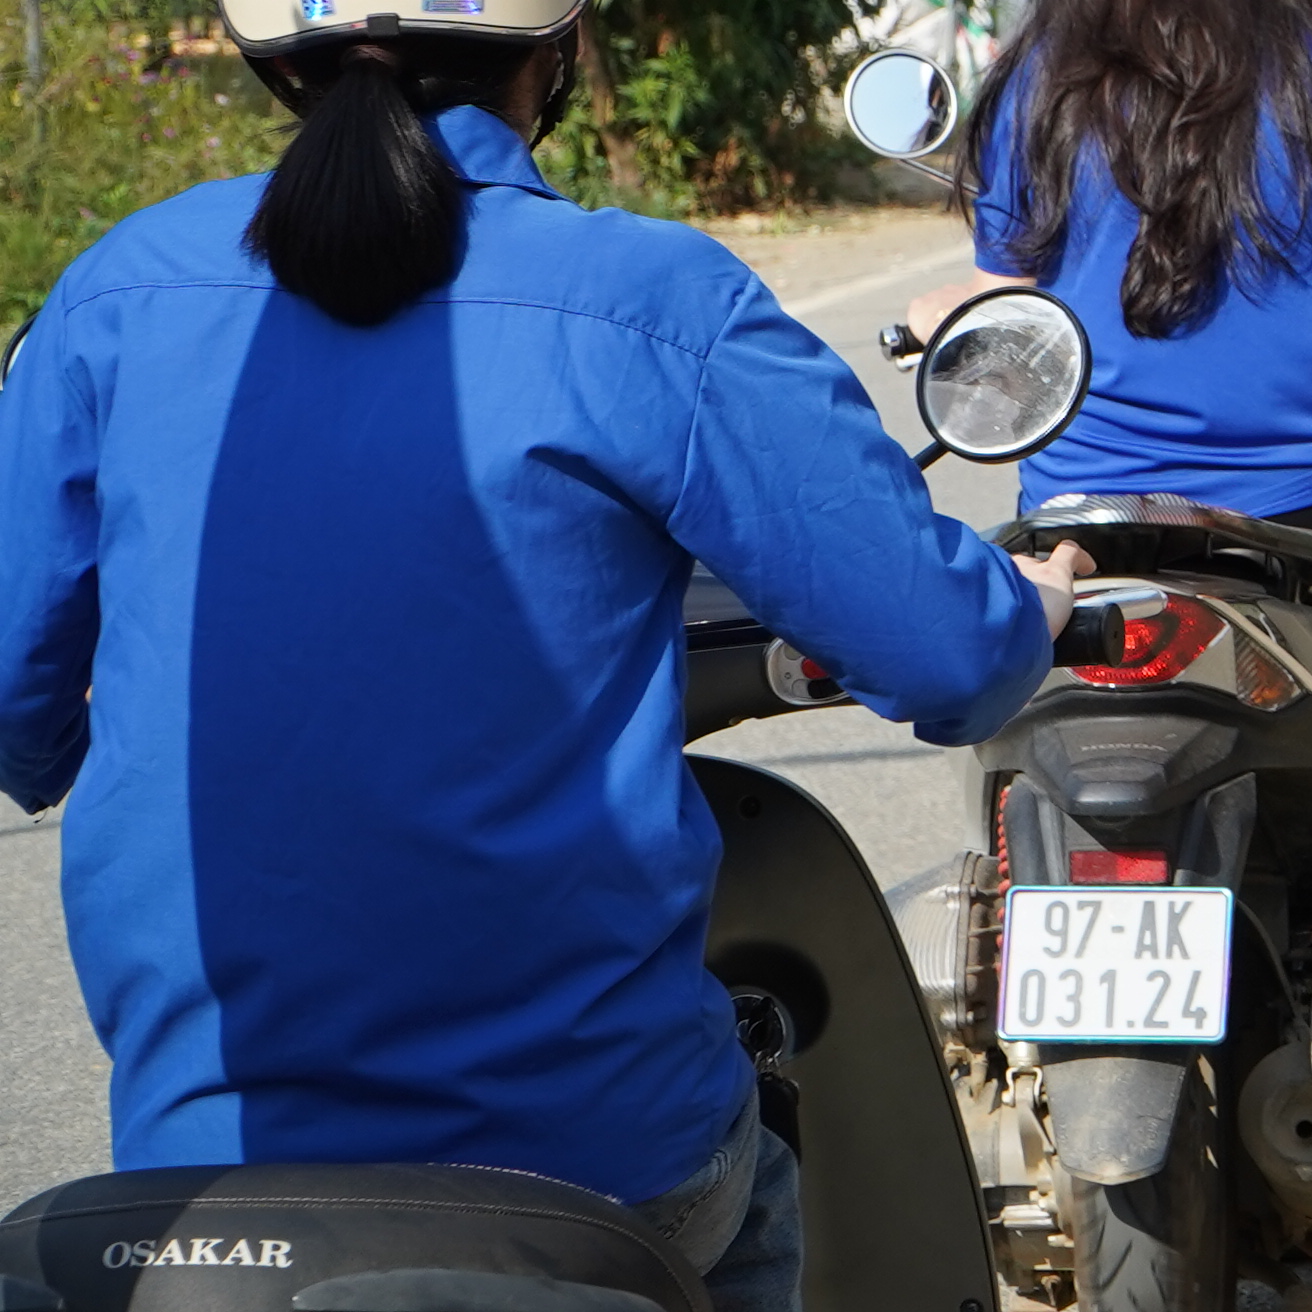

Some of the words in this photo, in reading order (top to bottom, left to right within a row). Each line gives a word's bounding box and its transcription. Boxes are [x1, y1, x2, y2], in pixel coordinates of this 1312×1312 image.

[1042, 900, 1194, 961] 97-AK
[1018, 968, 1208, 1030] 031.24
[102, 1238, 294, 1269] OSAKAR
